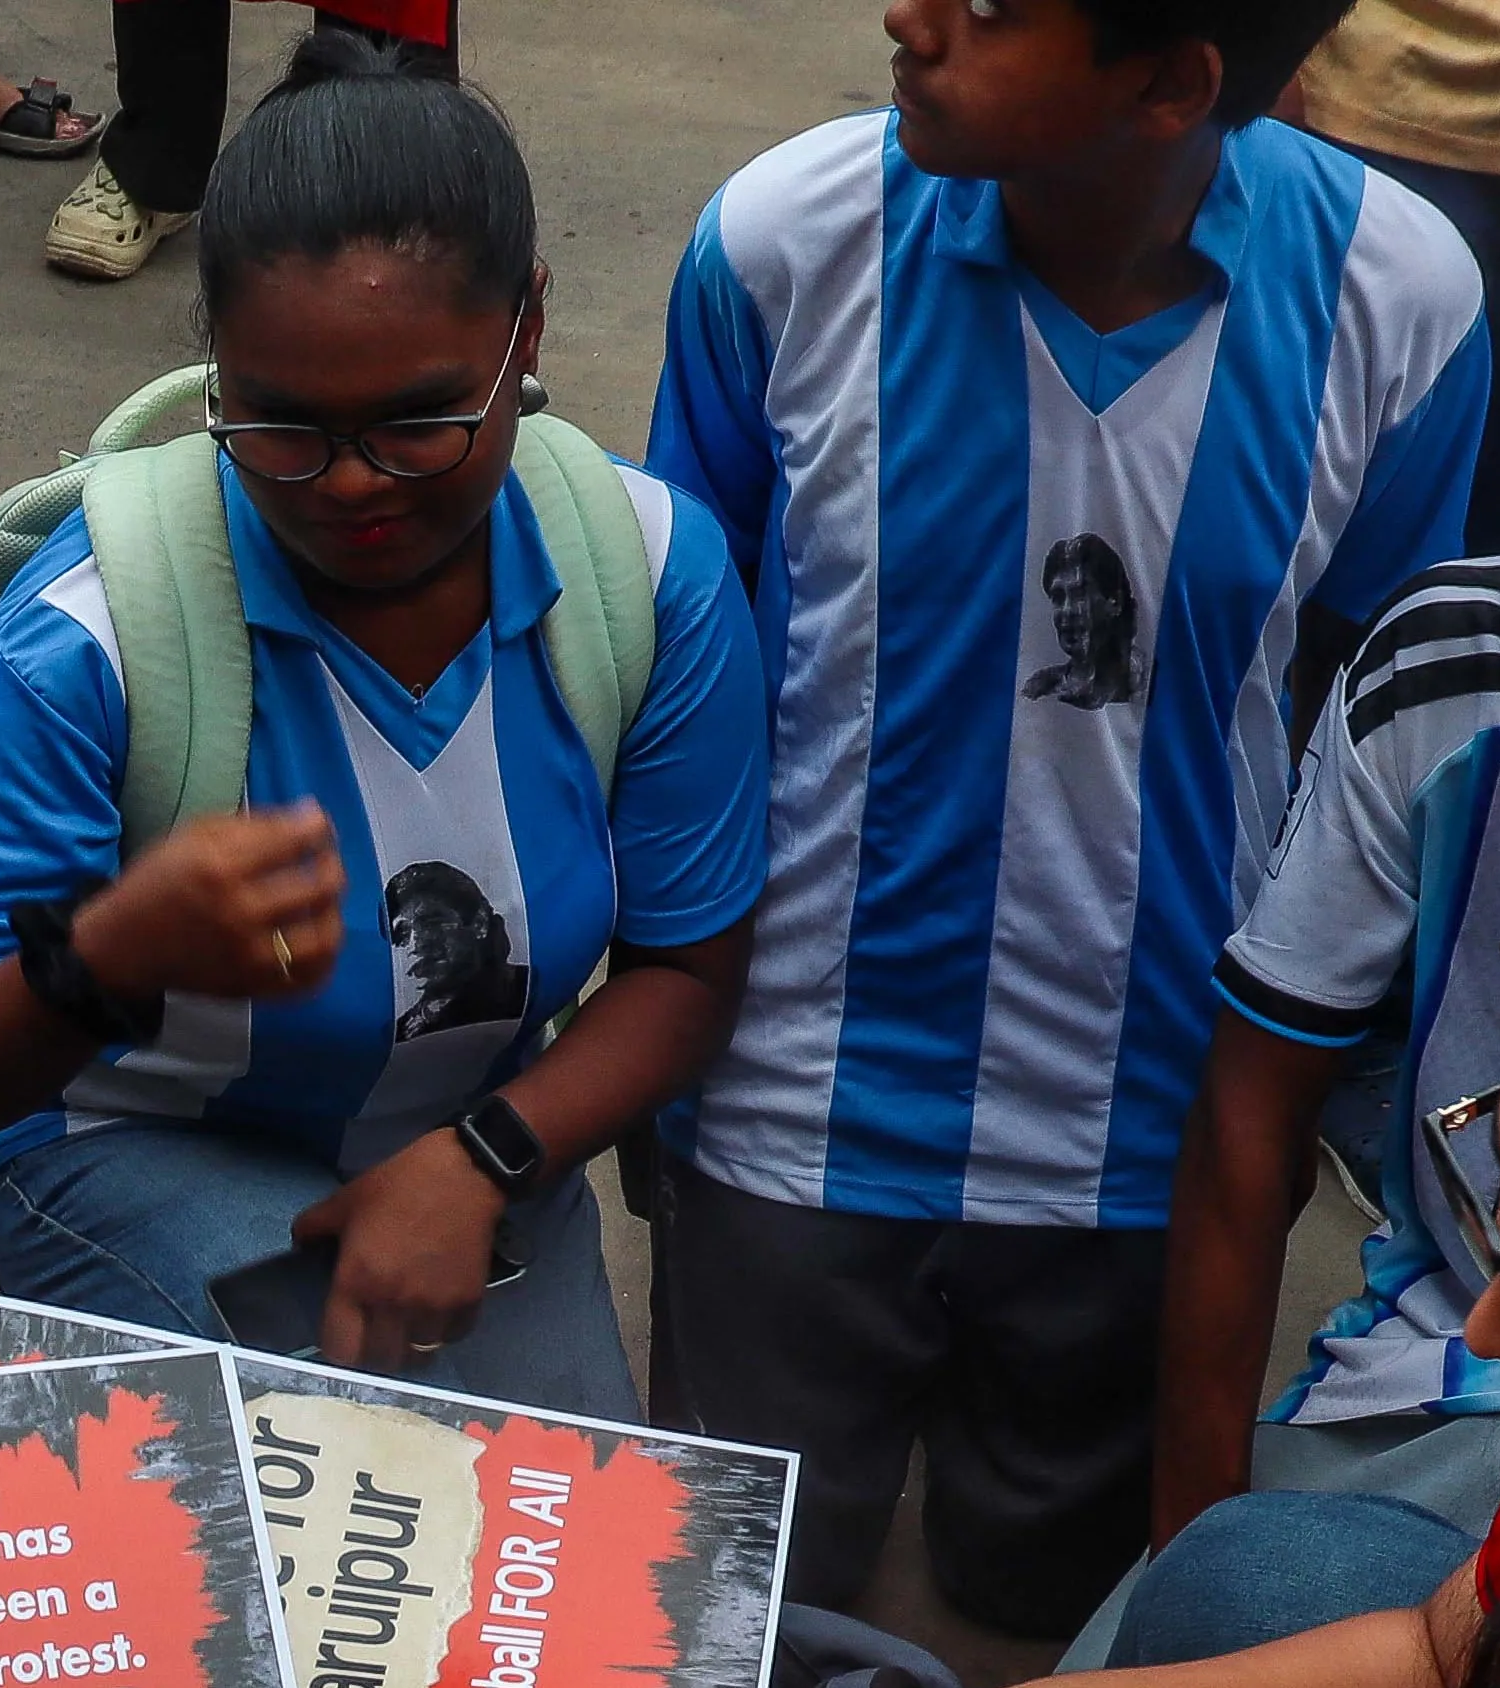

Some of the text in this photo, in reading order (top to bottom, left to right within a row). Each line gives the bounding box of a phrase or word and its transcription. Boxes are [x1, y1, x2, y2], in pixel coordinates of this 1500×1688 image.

[508, 1466, 573, 1528] All
[83, 1580, 117, 1611] a
[490, 1534, 561, 1620] FOR
